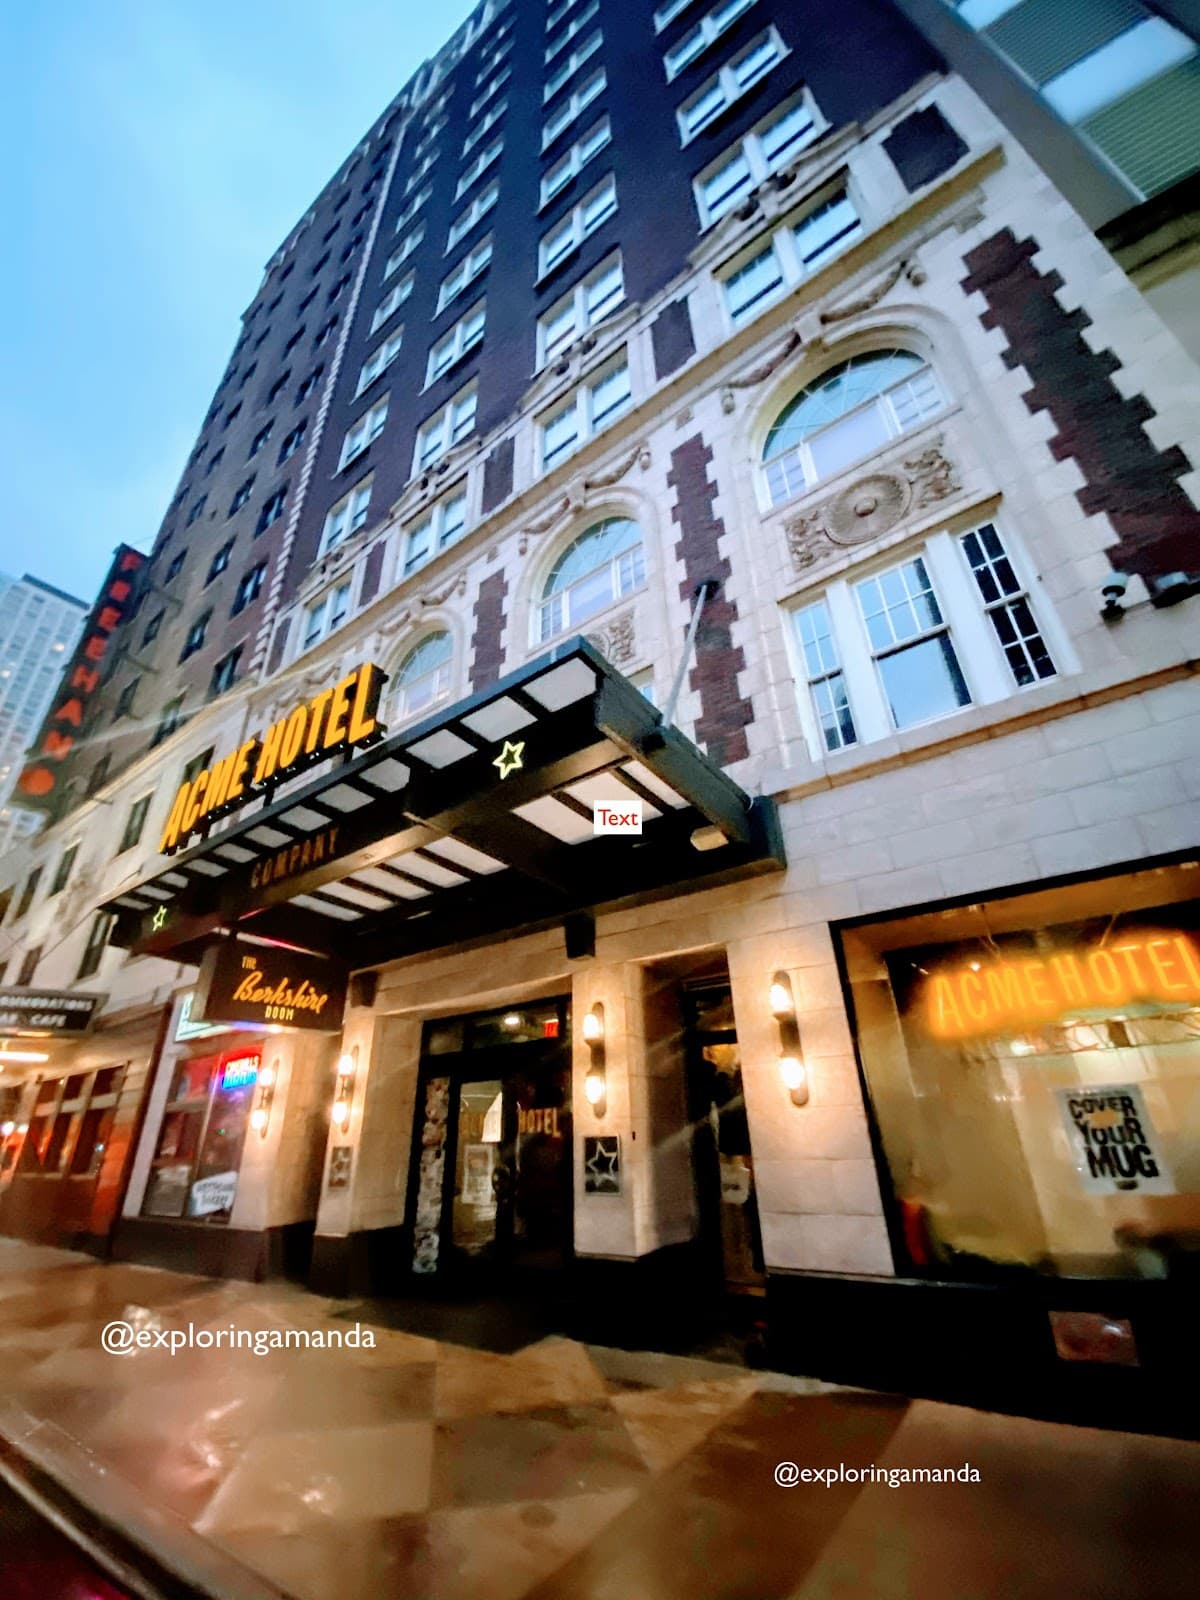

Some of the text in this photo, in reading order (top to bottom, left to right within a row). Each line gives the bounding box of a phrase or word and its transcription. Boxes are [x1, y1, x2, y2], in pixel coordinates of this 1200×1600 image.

[159, 662, 376, 853] ACME HOTEL
[250, 827, 338, 889] COMPANY
[242, 955, 257, 970] THE
[233, 970, 328, 1014] Berkshire
[932, 962, 1055, 1032] ACME
[518, 1107, 562, 1139] HOTEL
[1068, 1095, 1137, 1119] COVER
[1074, 1116, 1146, 1146] YOUR
[1084, 1144, 1160, 1179] MUG
